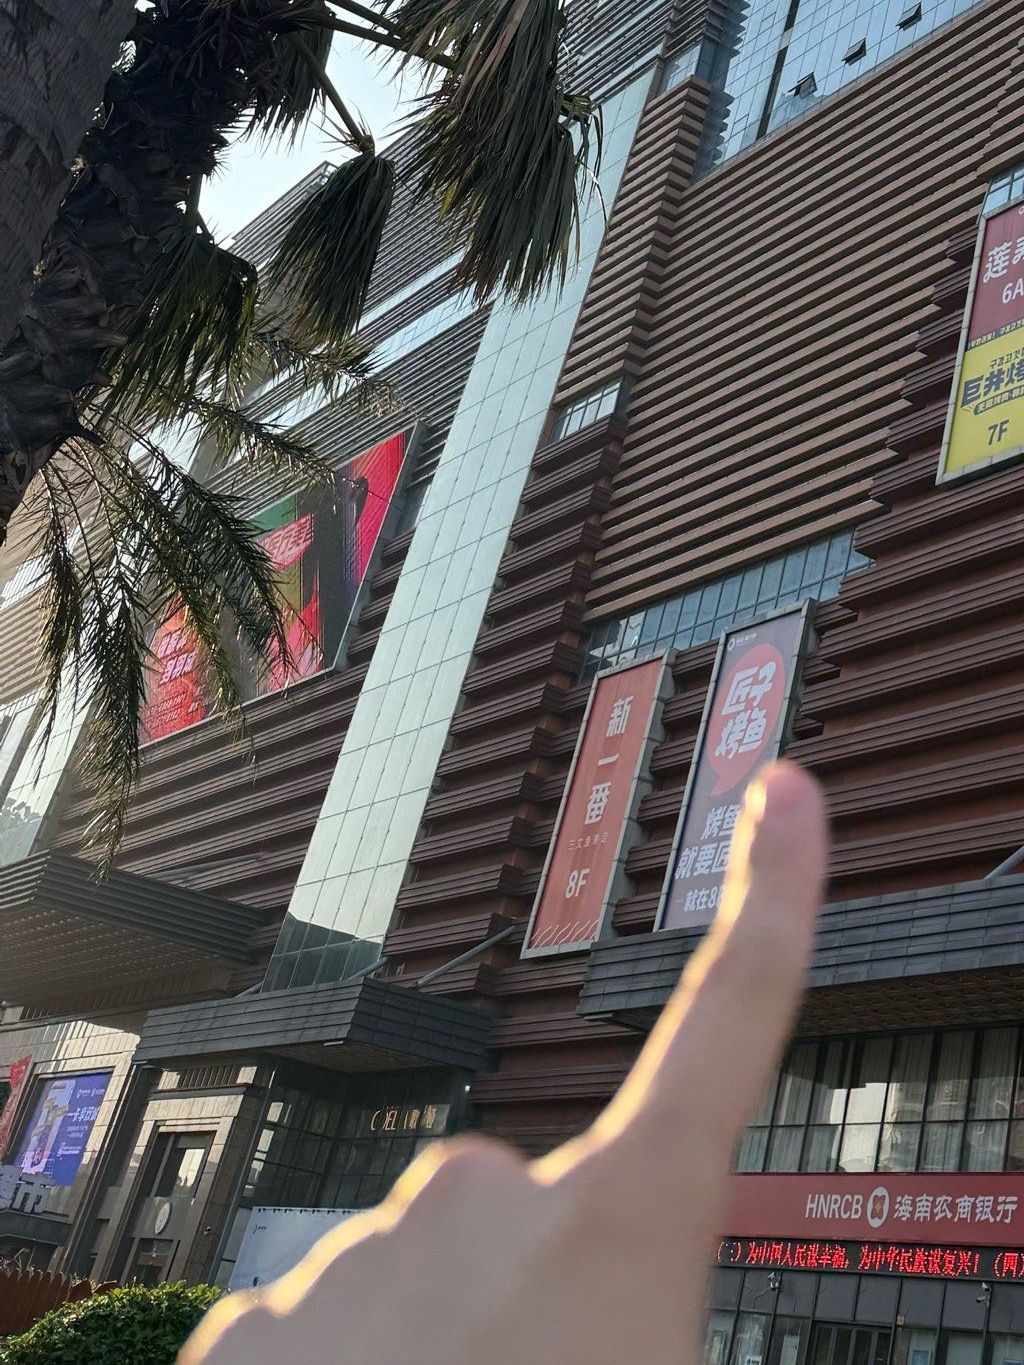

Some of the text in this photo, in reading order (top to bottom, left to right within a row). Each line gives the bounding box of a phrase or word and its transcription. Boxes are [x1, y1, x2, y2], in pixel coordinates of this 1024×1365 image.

[988, 419, 1010, 446] 7F
[584, 695, 634, 825] 新一番
[565, 868, 591, 899] 8F
[805, 1193, 864, 1220] HNRCB
[893, 1193, 1018, 1225] 海南农商银行
